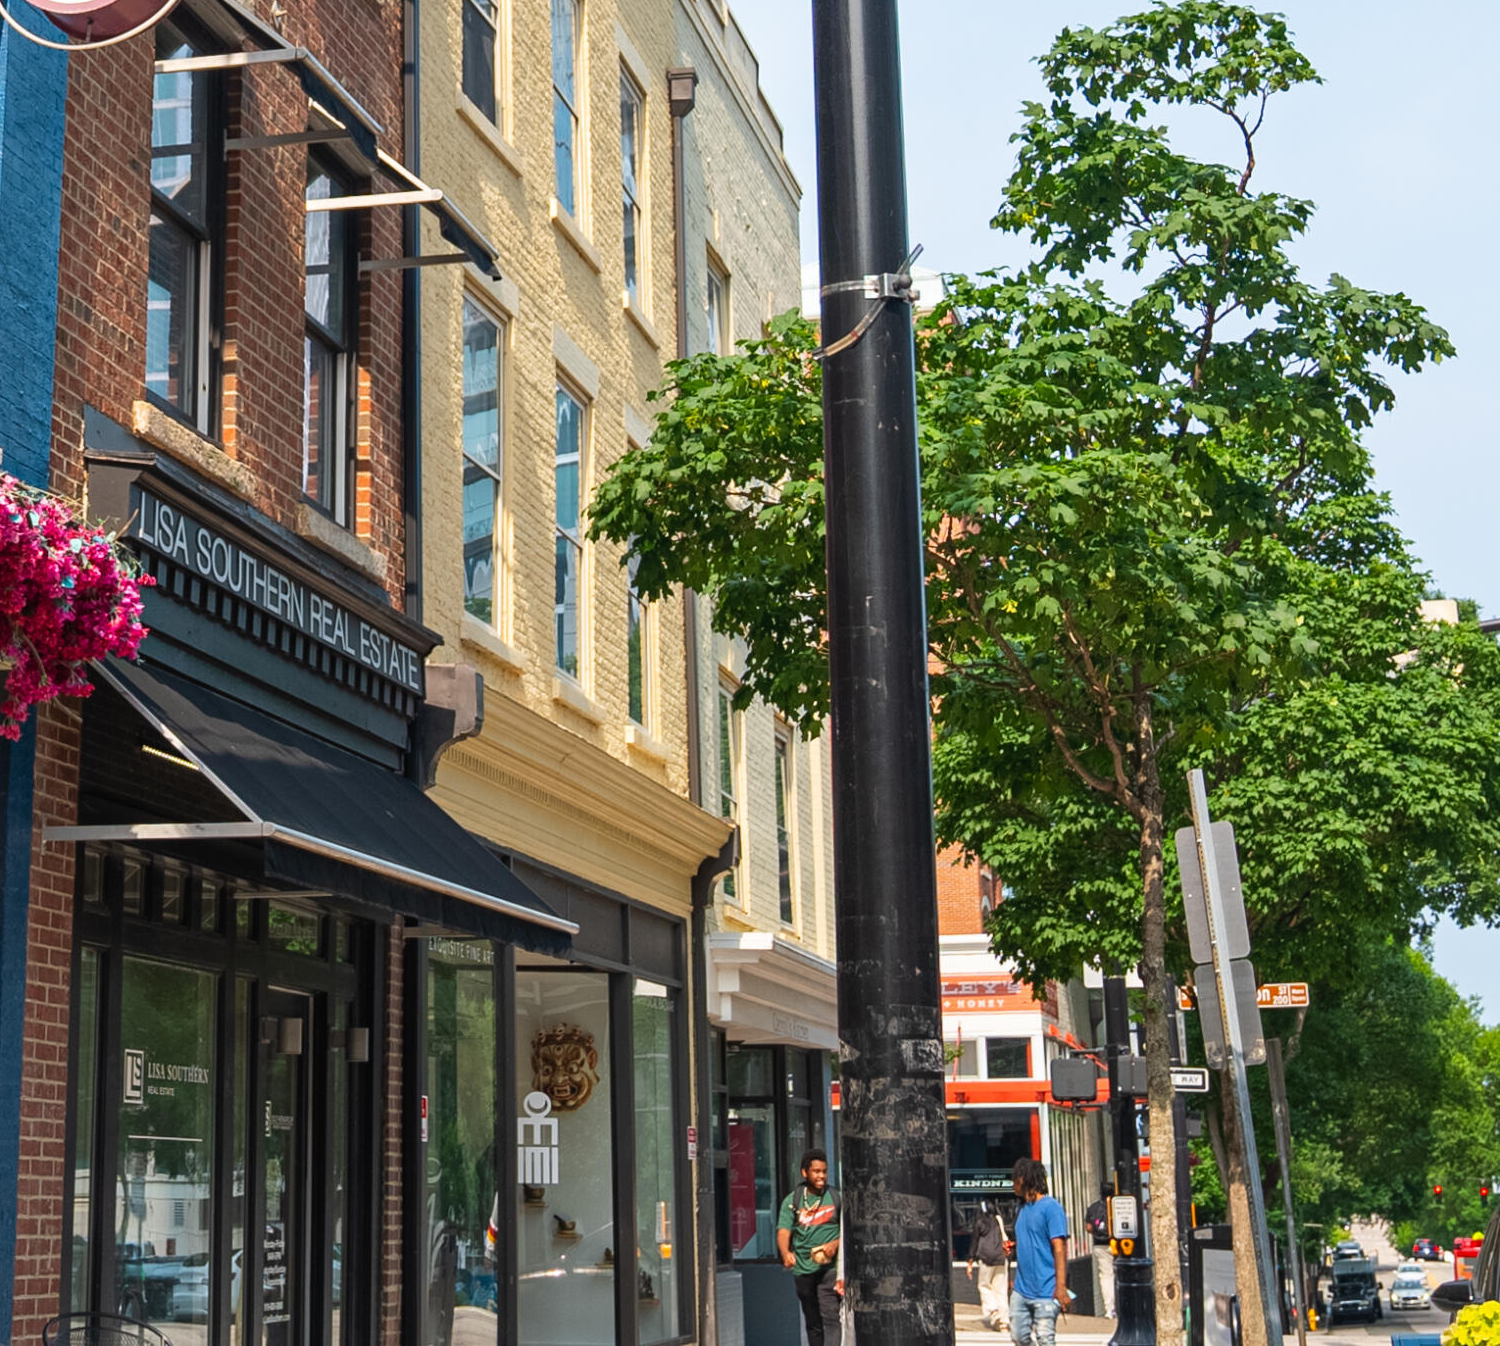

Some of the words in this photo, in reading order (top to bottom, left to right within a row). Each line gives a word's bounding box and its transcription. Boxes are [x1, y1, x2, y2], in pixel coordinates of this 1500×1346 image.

[139, 491, 189, 566] LISA
[197, 527, 304, 628] SOUTHERN
[310, 593, 356, 656] REAL
[360, 621, 419, 691] ESTATE
[941, 981, 1022, 994] LEY'S
[957, 999, 1005, 1008] HONEY
[148, 1062, 166, 1080] LISA
[167, 1063, 210, 1084] SOUTHERN
[1181, 1076, 1200, 1084] WAY
[148, 1085, 159, 1096] REAL
[159, 1086, 175, 1097] ESTATE
[953, 1179, 1013, 1188] KINDNE
